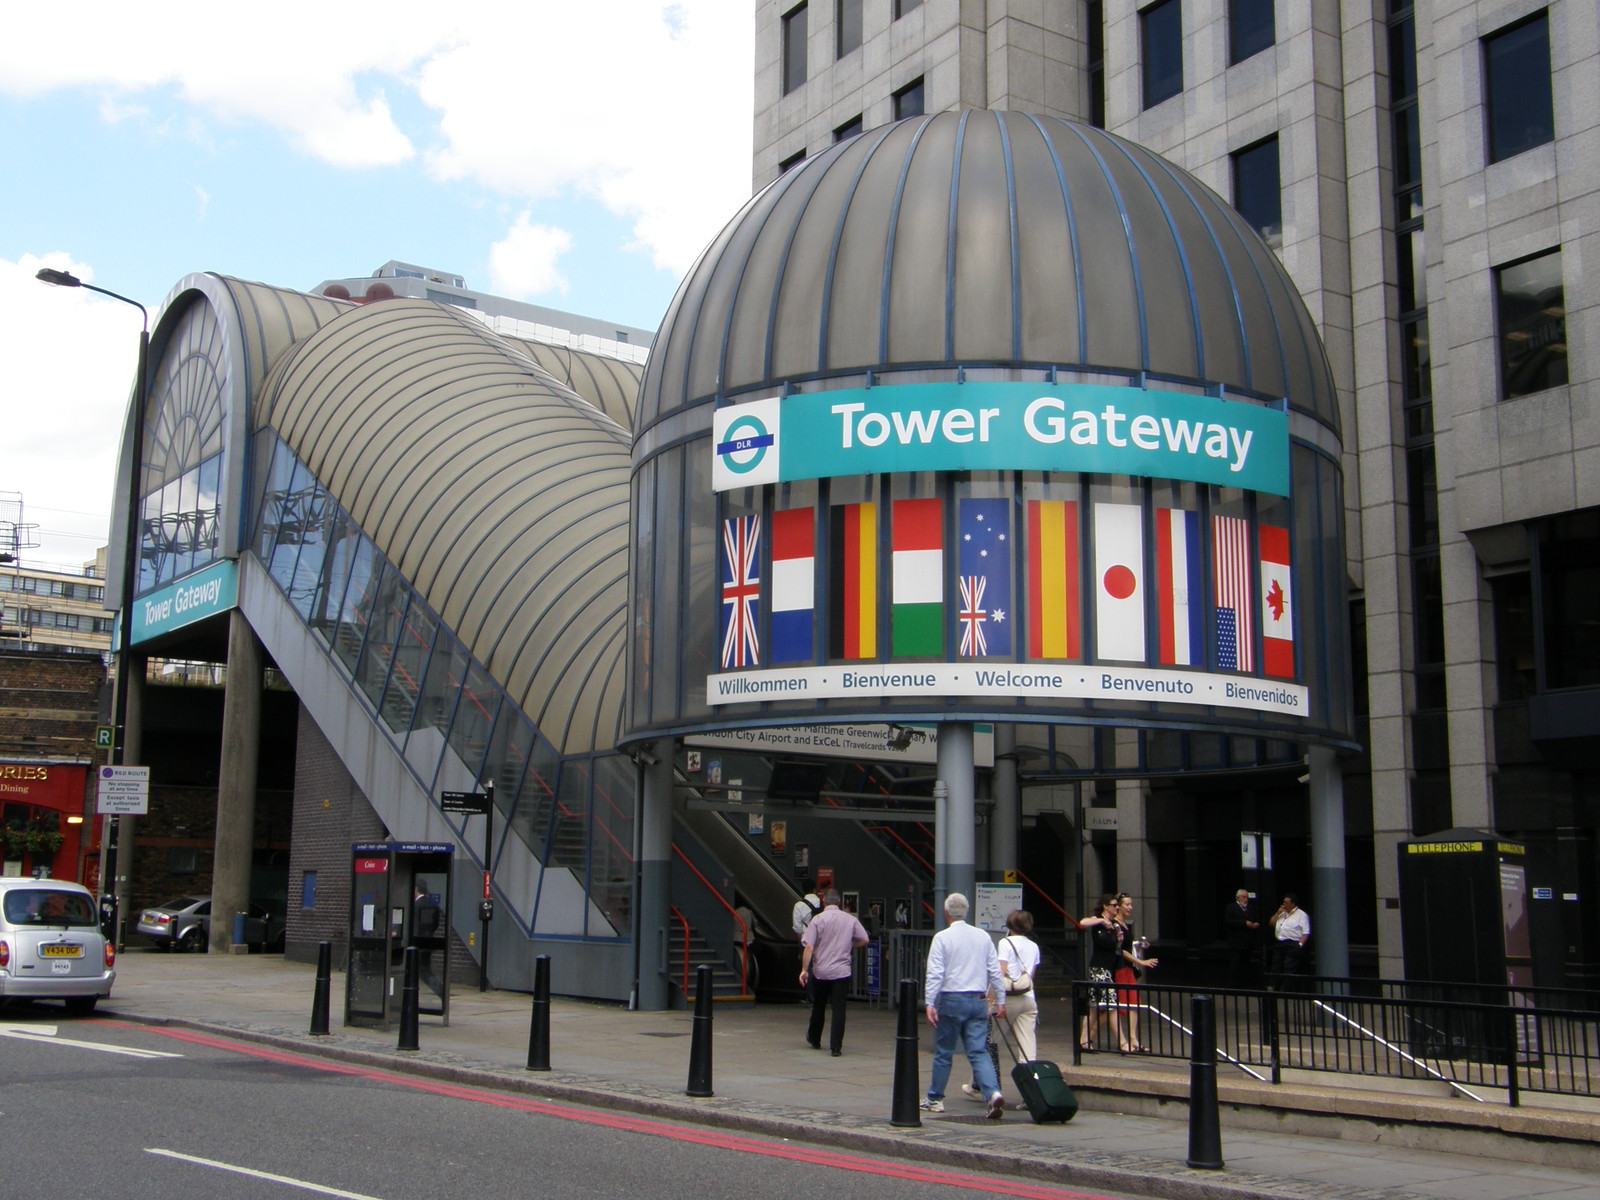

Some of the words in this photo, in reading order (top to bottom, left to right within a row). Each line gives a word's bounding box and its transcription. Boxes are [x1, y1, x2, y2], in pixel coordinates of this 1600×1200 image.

[831, 402, 1001, 448] Tower
[1023, 396, 1254, 472] Gateway
[736, 440, 752, 449] DLR
[145, 599, 172, 626] Tower
[175, 578, 221, 613] Gateway
[718, 676, 808, 695] Willkommen
[842, 671, 936, 688] Bienvenue
[975, 670, 1063, 688] Welcome
[1101, 674, 1194, 694] Benvenuto
[1225, 682, 1299, 707] Bienvenidos
[99, 730, 110, 744] R
[804, 726, 844, 735] Maritime
[736, 730, 756, 742] City
[758, 732, 791, 744] Airport
[793, 736, 811, 745] and
[813, 736, 841, 747] ExCeL
[843, 740, 887, 751] (Travelcards
[0, 784, 29, 793] Dining
[1415, 842, 1476, 853] TELEPHONE
